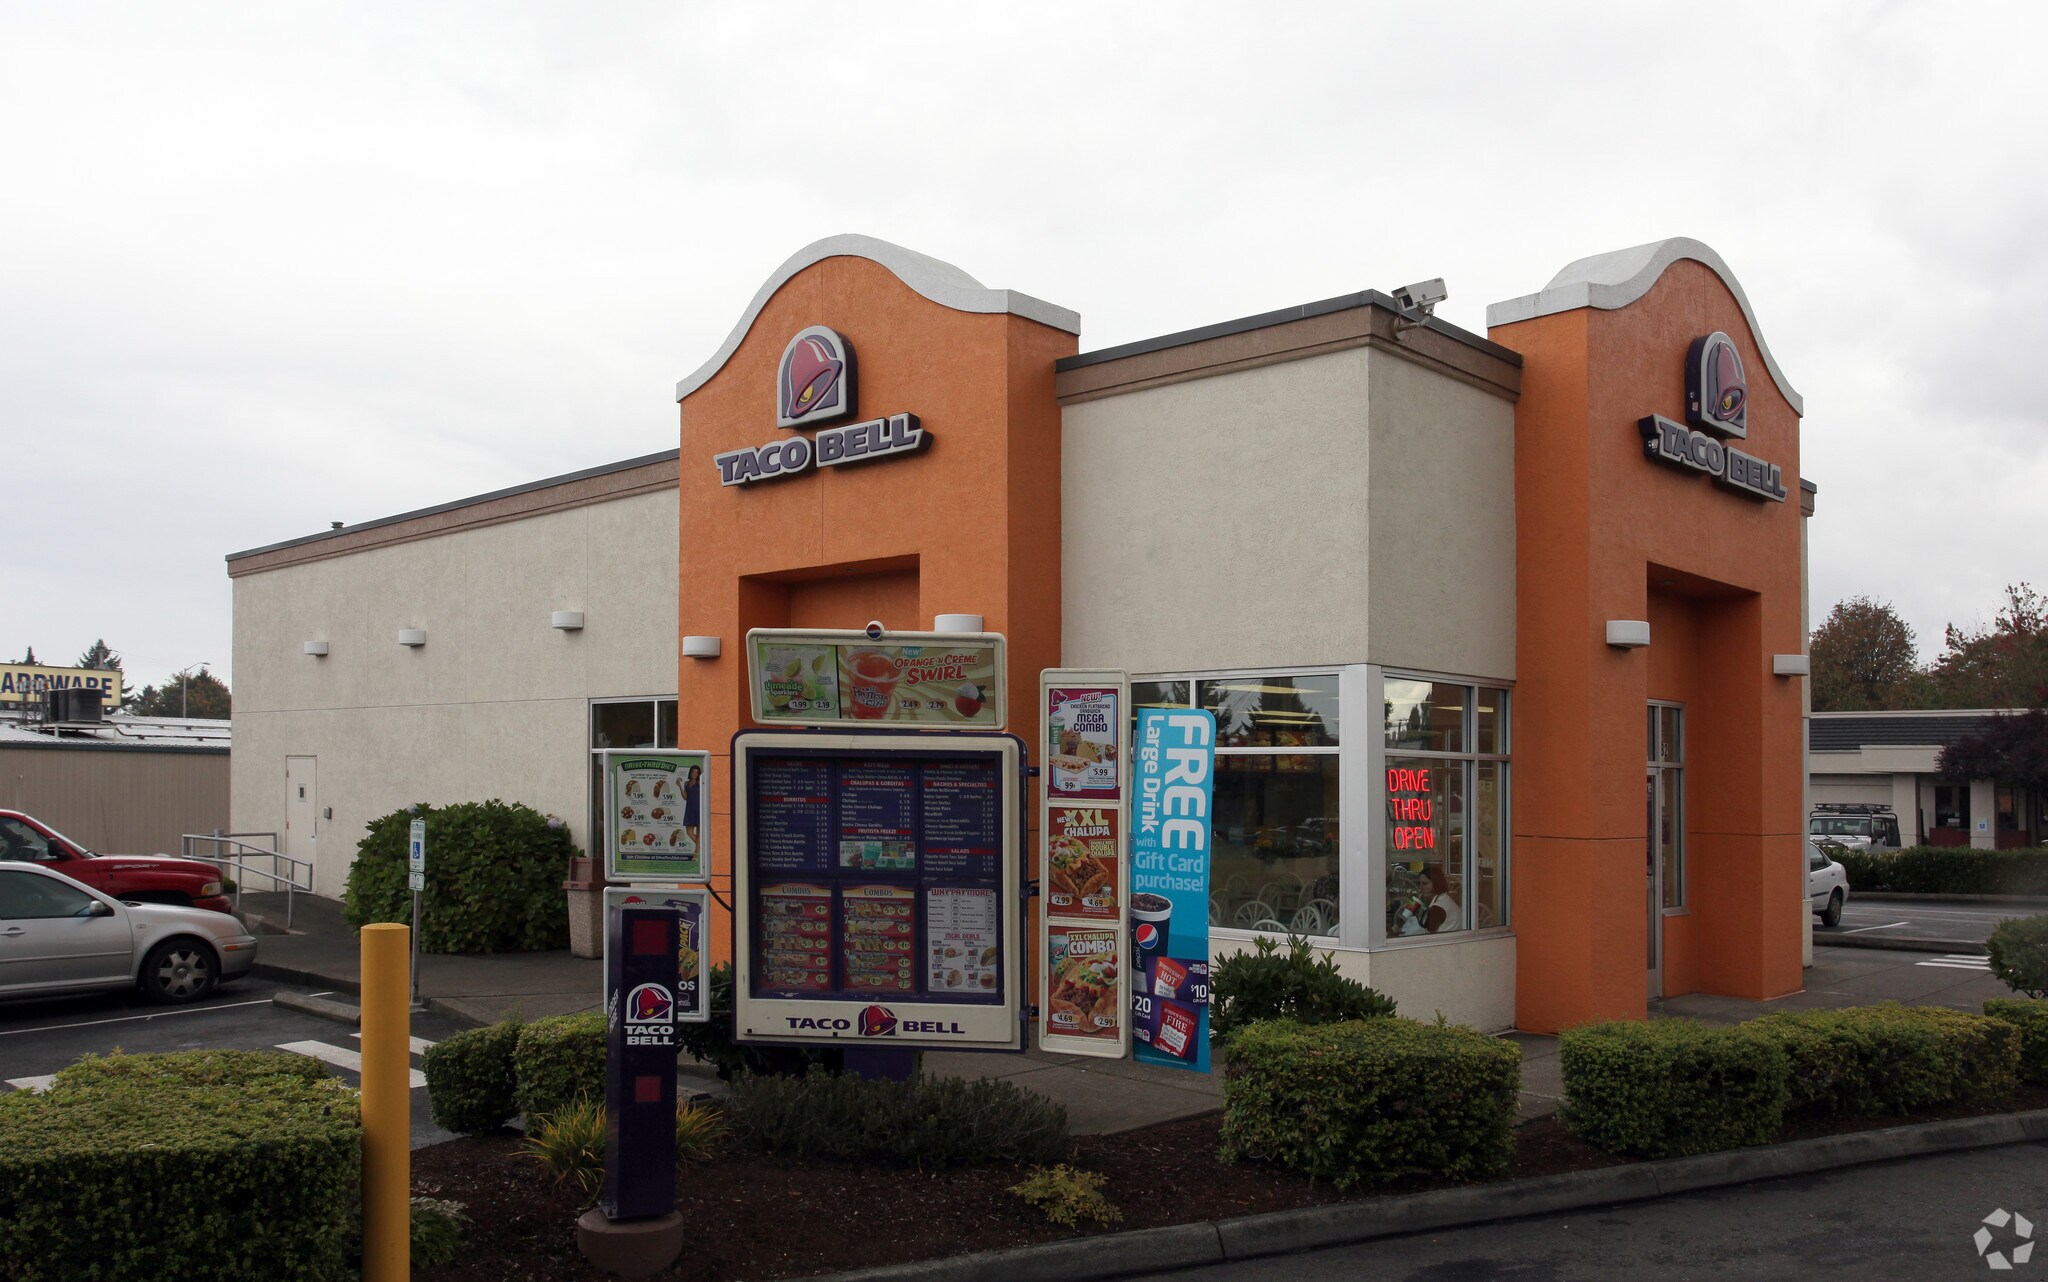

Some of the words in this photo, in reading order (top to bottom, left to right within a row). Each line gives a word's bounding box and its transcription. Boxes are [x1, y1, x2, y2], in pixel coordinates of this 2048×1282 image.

[716, 442, 809, 484] TACO
[817, 416, 920, 464] BELL
[1658, 420, 1724, 472] TACO
[1730, 451, 1787, 499] BELL
[901, 648, 922, 656] New!
[894, 656, 935, 669] ORANGE
[905, 665, 968, 686] SWIRL
[764, 679, 804, 691] Limeade
[770, 689, 799, 697] Sparklers
[1080, 692, 1101, 702] NEW!
[1077, 713, 1104, 723] MEGA
[1073, 722, 1108, 733] COMBO
[1141, 714, 1165, 774] Large
[1161, 714, 1210, 851] FREE
[1388, 768, 1431, 792] DRIVE
[1141, 777, 1161, 834] Drink
[1391, 798, 1432, 821] THRU
[1063, 809, 1109, 827] XXL
[1063, 826, 1111, 837] CHALUPA
[1136, 837, 1156, 848] with
[1394, 826, 1435, 850] OPEN
[1135, 851, 1165, 871] Gift
[1167, 853, 1204, 873] Card
[1135, 873, 1204, 892] purchase!
[782, 885, 811, 895] COMBOS
[863, 887, 893, 897] COMBOS
[931, 888, 950, 897] WHY
[950, 888, 967, 897] PAY
[966, 889, 993, 898] MORE!
[844, 898, 850, 908] 6
[762, 913, 768, 923] 2
[843, 915, 849, 924] 7
[762, 932, 768, 941] 3
[844, 933, 850, 942] 8
[1069, 933, 1083, 941] XXL
[1069, 940, 1116, 954] COMBO
[761, 949, 768, 958] 4
[844, 949, 850, 958] 9
[763, 965, 768, 974] 5
[1160, 970, 1178, 985] HOT
[678, 980, 695, 991] OS
[1190, 984, 1207, 998] $10
[1132, 995, 1152, 1014] $20
[785, 1017, 851, 1030] TACO
[902, 1020, 966, 1034] BELL
[1166, 1015, 1188, 1033] FIRE
[623, 1025, 674, 1035] TACO
[626, 1036, 674, 1046] BELL
